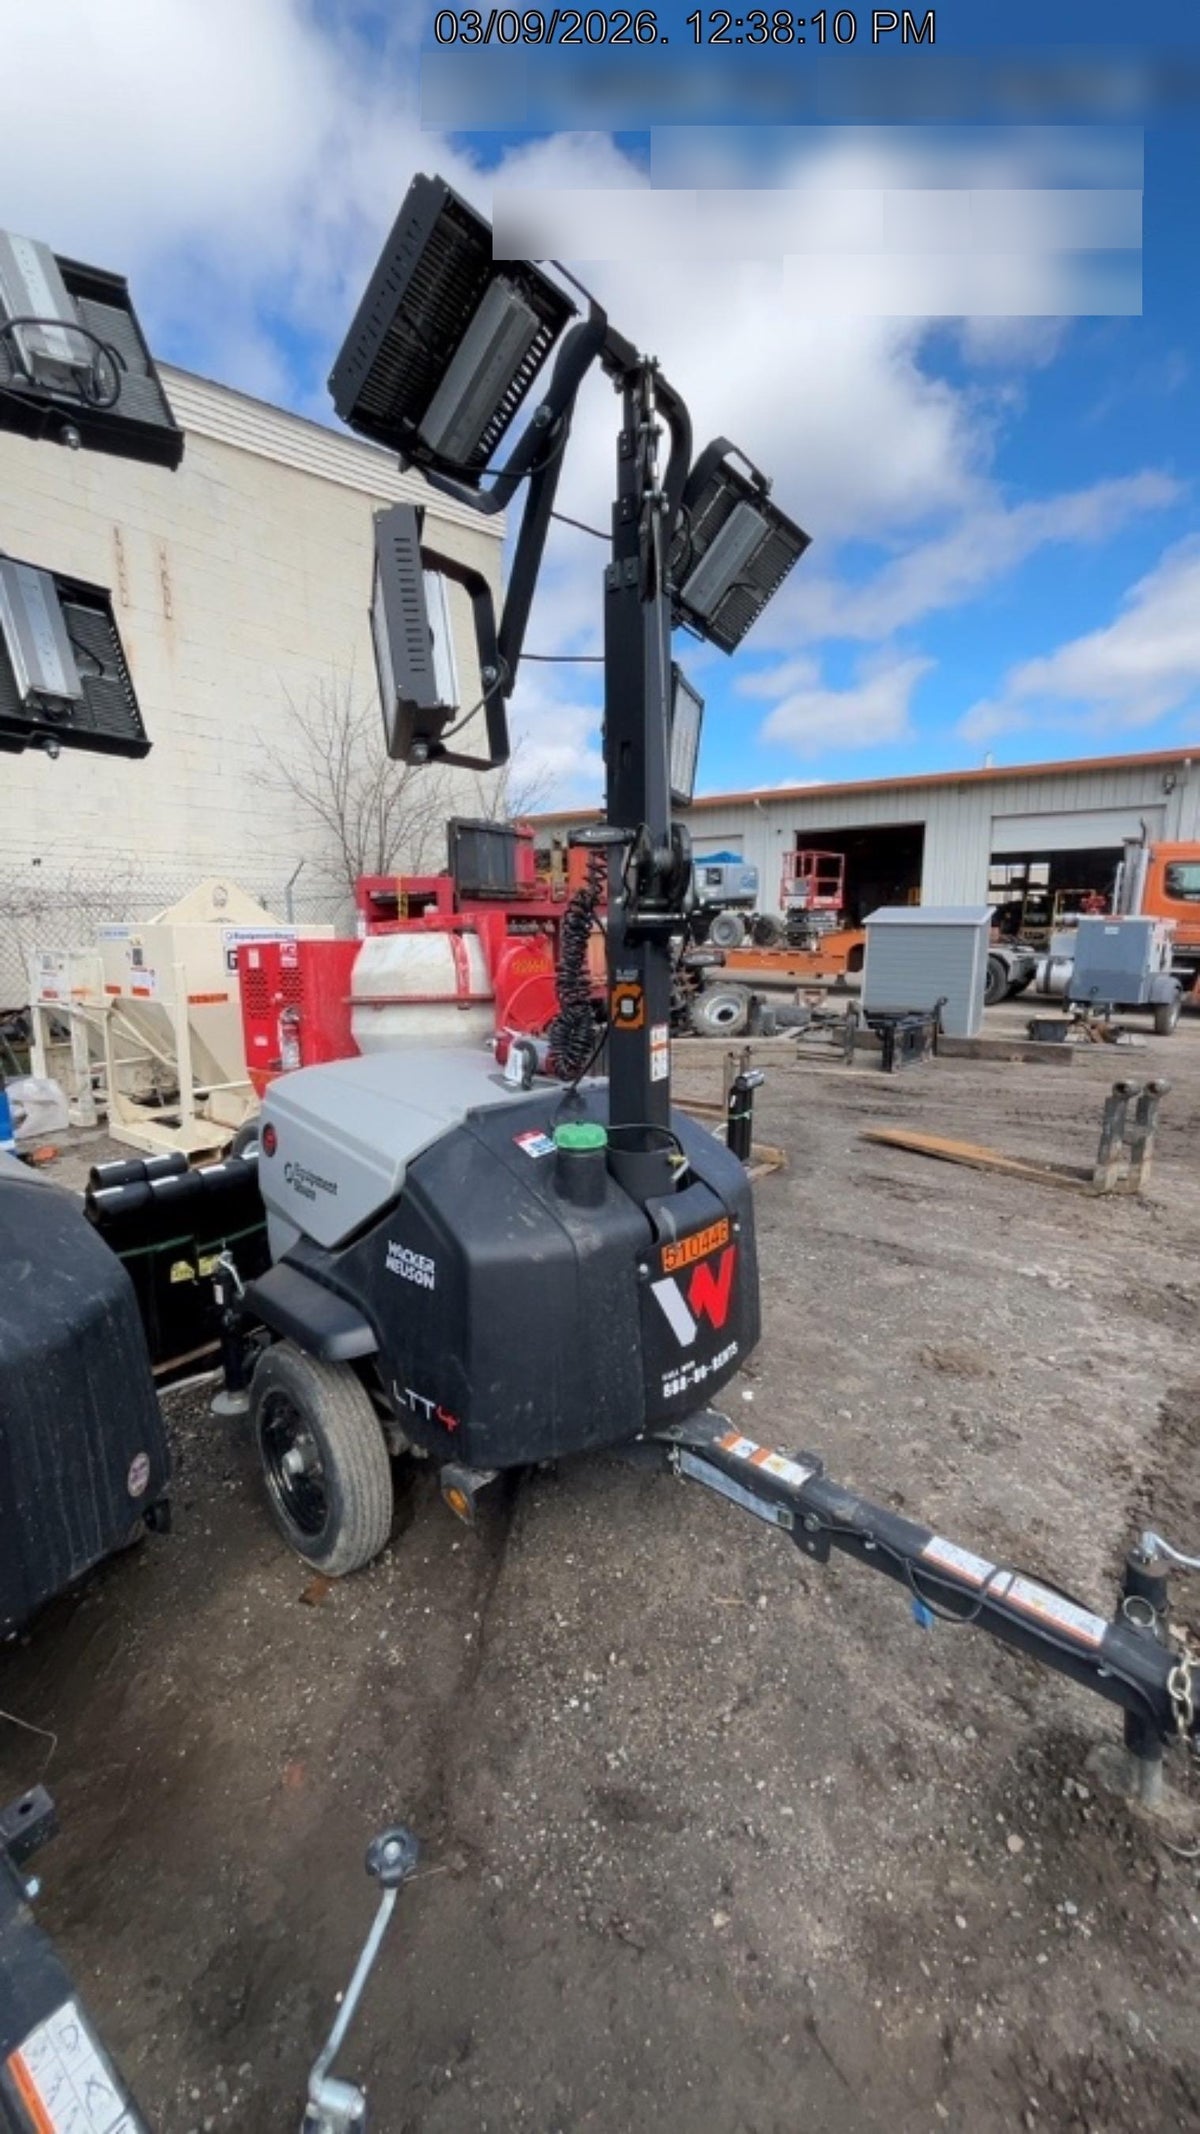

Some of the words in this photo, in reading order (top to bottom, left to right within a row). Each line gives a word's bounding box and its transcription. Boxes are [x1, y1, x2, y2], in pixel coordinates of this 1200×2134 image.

[385, 1254, 435, 1291] NEUSON
[388, 1239, 435, 1275] WACKER
[392, 1379, 458, 1432] LTT4
